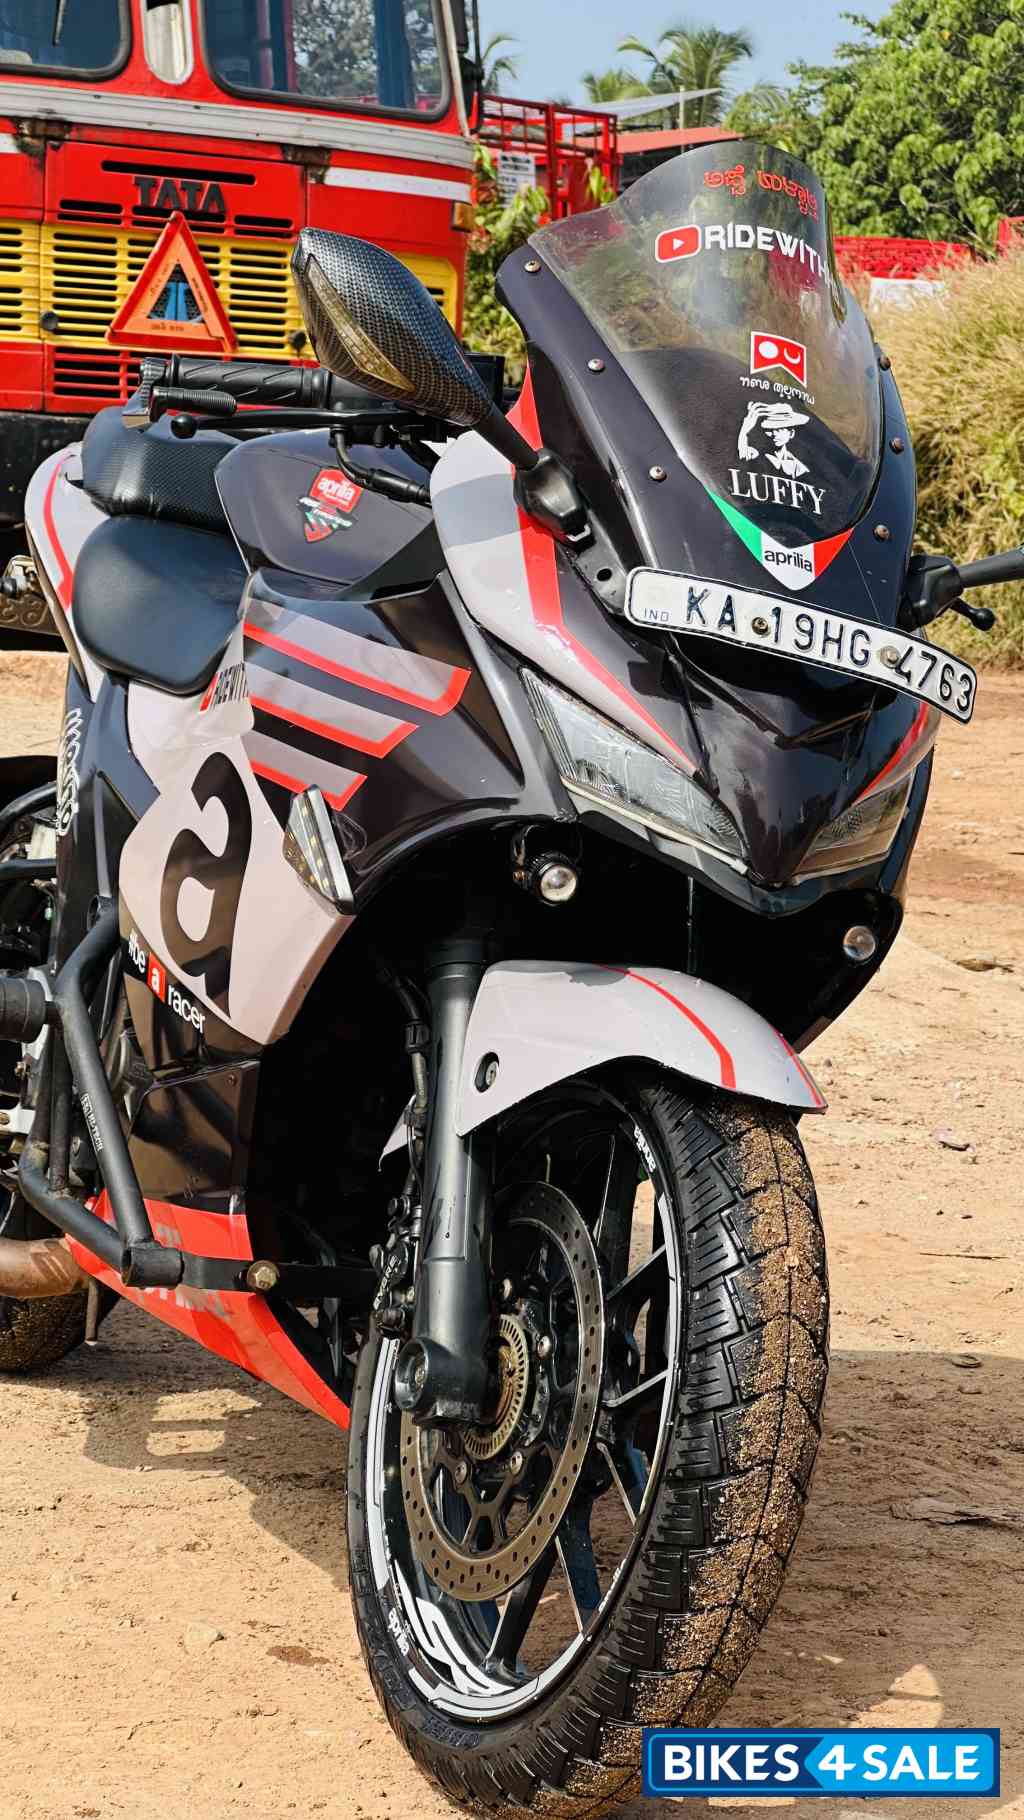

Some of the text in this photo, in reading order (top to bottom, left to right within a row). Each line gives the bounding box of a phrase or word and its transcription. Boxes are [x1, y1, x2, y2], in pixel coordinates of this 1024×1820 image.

[134, 175, 226, 213] TATA
[728, 468, 826, 515] LUFFY
[763, 548, 813, 573] aprilia
[685, 586, 737, 633] KA
[893, 645, 975, 713] 4763
[167, 984, 206, 1034] racer
